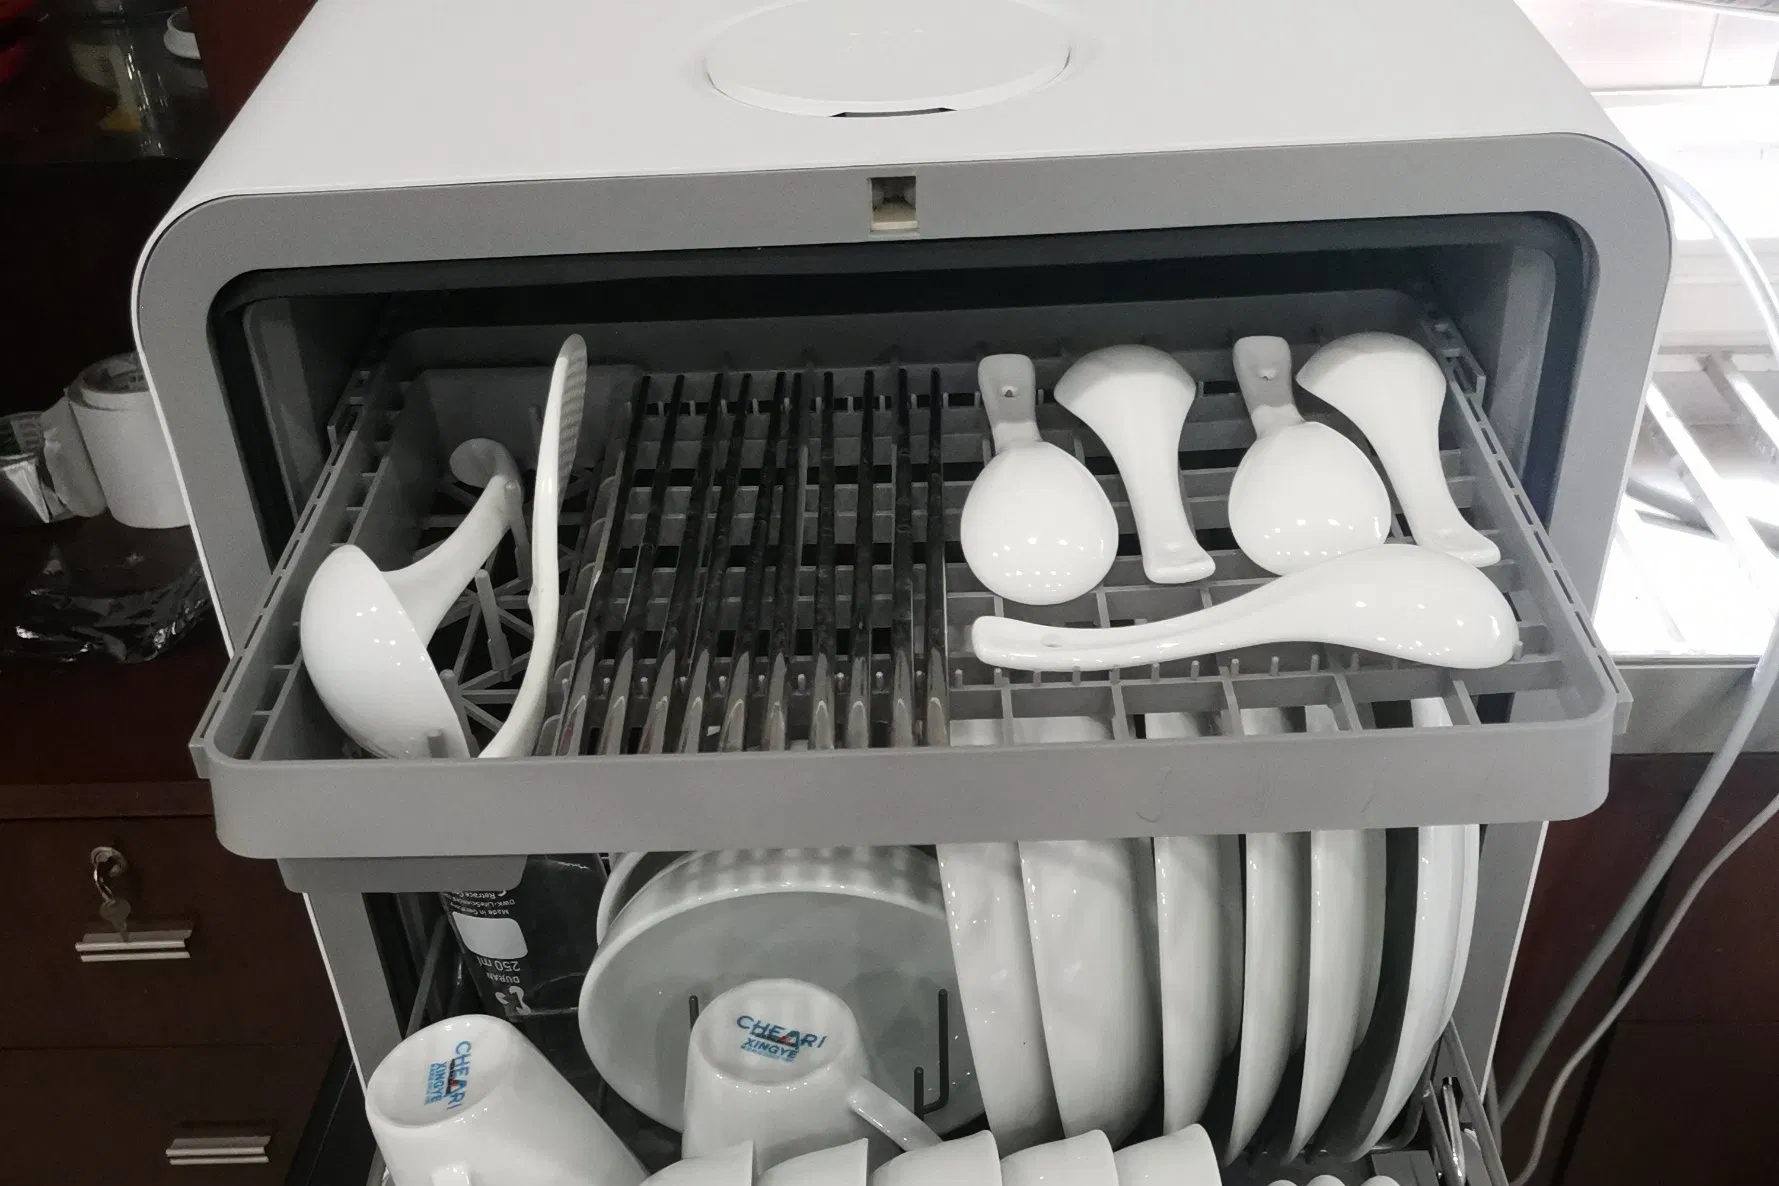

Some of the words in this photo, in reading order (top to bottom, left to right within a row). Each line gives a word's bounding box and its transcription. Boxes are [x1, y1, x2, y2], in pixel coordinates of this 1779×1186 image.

[476, 956, 492, 966] ml
[494, 960, 521, 972] 250
[486, 972, 520, 983] DURAN
[737, 1015, 827, 1050] CHEARI
[744, 1037, 798, 1059] XINGYE
[444, 1041, 472, 1111] CHEARI
